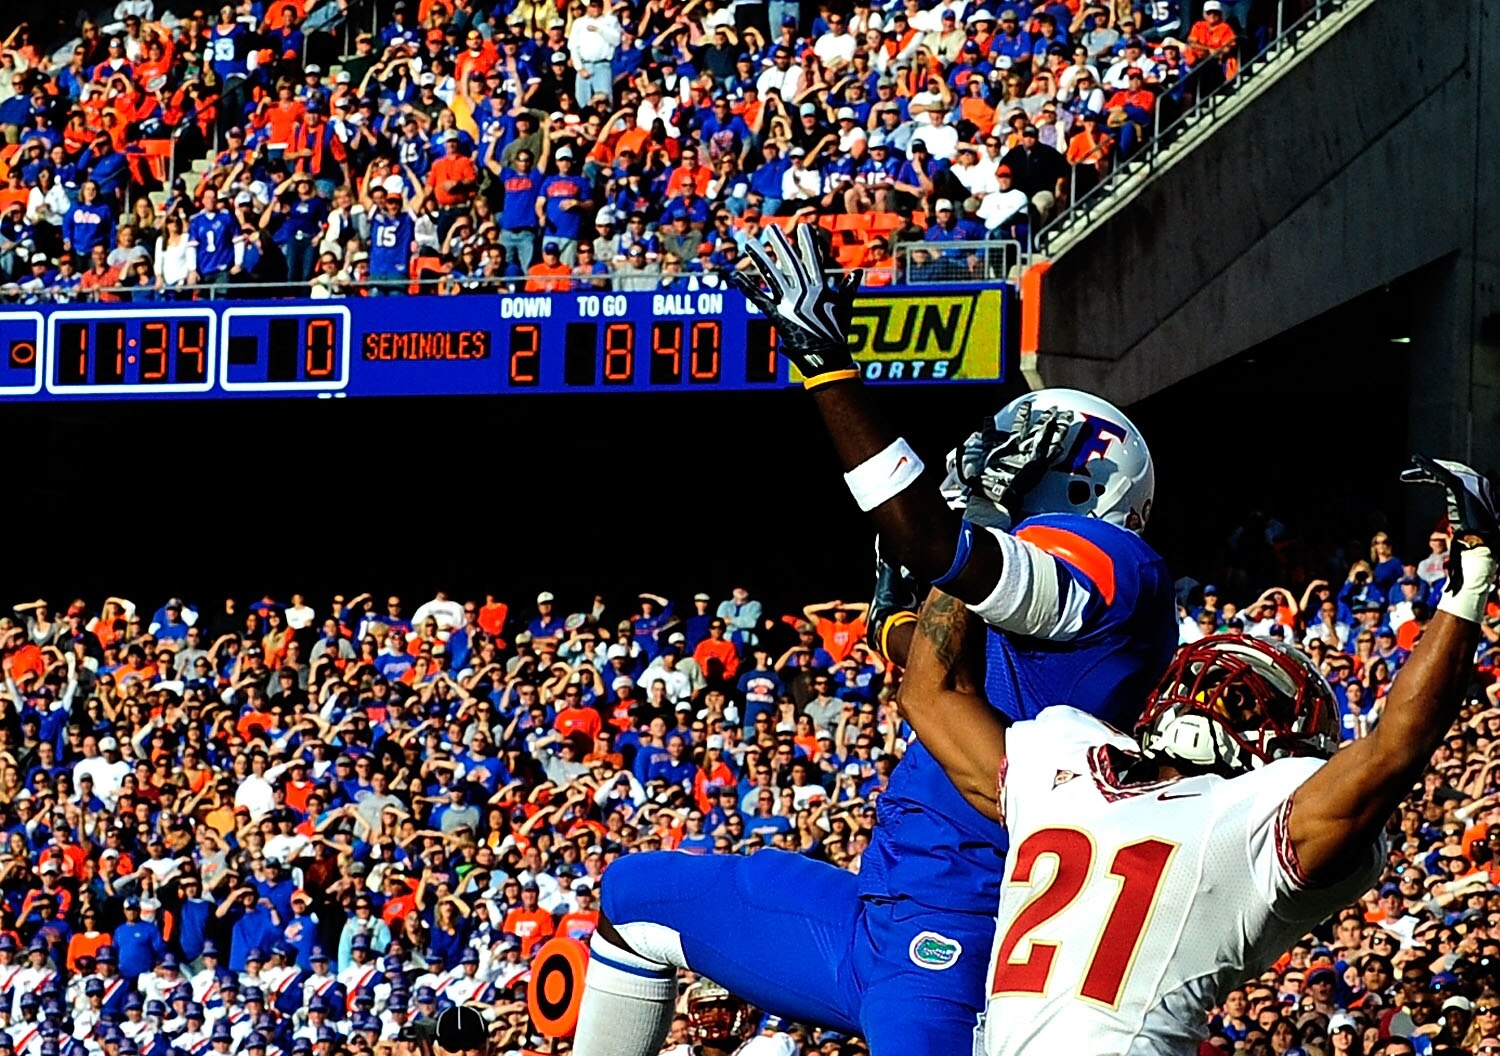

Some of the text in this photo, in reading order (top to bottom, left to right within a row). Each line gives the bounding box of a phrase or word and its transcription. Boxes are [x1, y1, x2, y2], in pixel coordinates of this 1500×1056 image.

[206, 230, 216, 253] 1
[376, 225, 397, 247] 15
[501, 297, 552, 319] DOWN
[577, 295, 627, 317] TO GO
[653, 294, 695, 315] BALL
[697, 293, 723, 314] ON
[306, 319, 333, 376] 0
[366, 332, 486, 360] SEMINOLES
[848, 304, 962, 353] SUN
[79, 323, 205, 378] 11:34
[511, 325, 538, 382] 2
[605, 324, 633, 380] 8
[653, 322, 719, 379] 40
[857, 360, 950, 380] ORTS
[989, 822, 1182, 1012] 21
